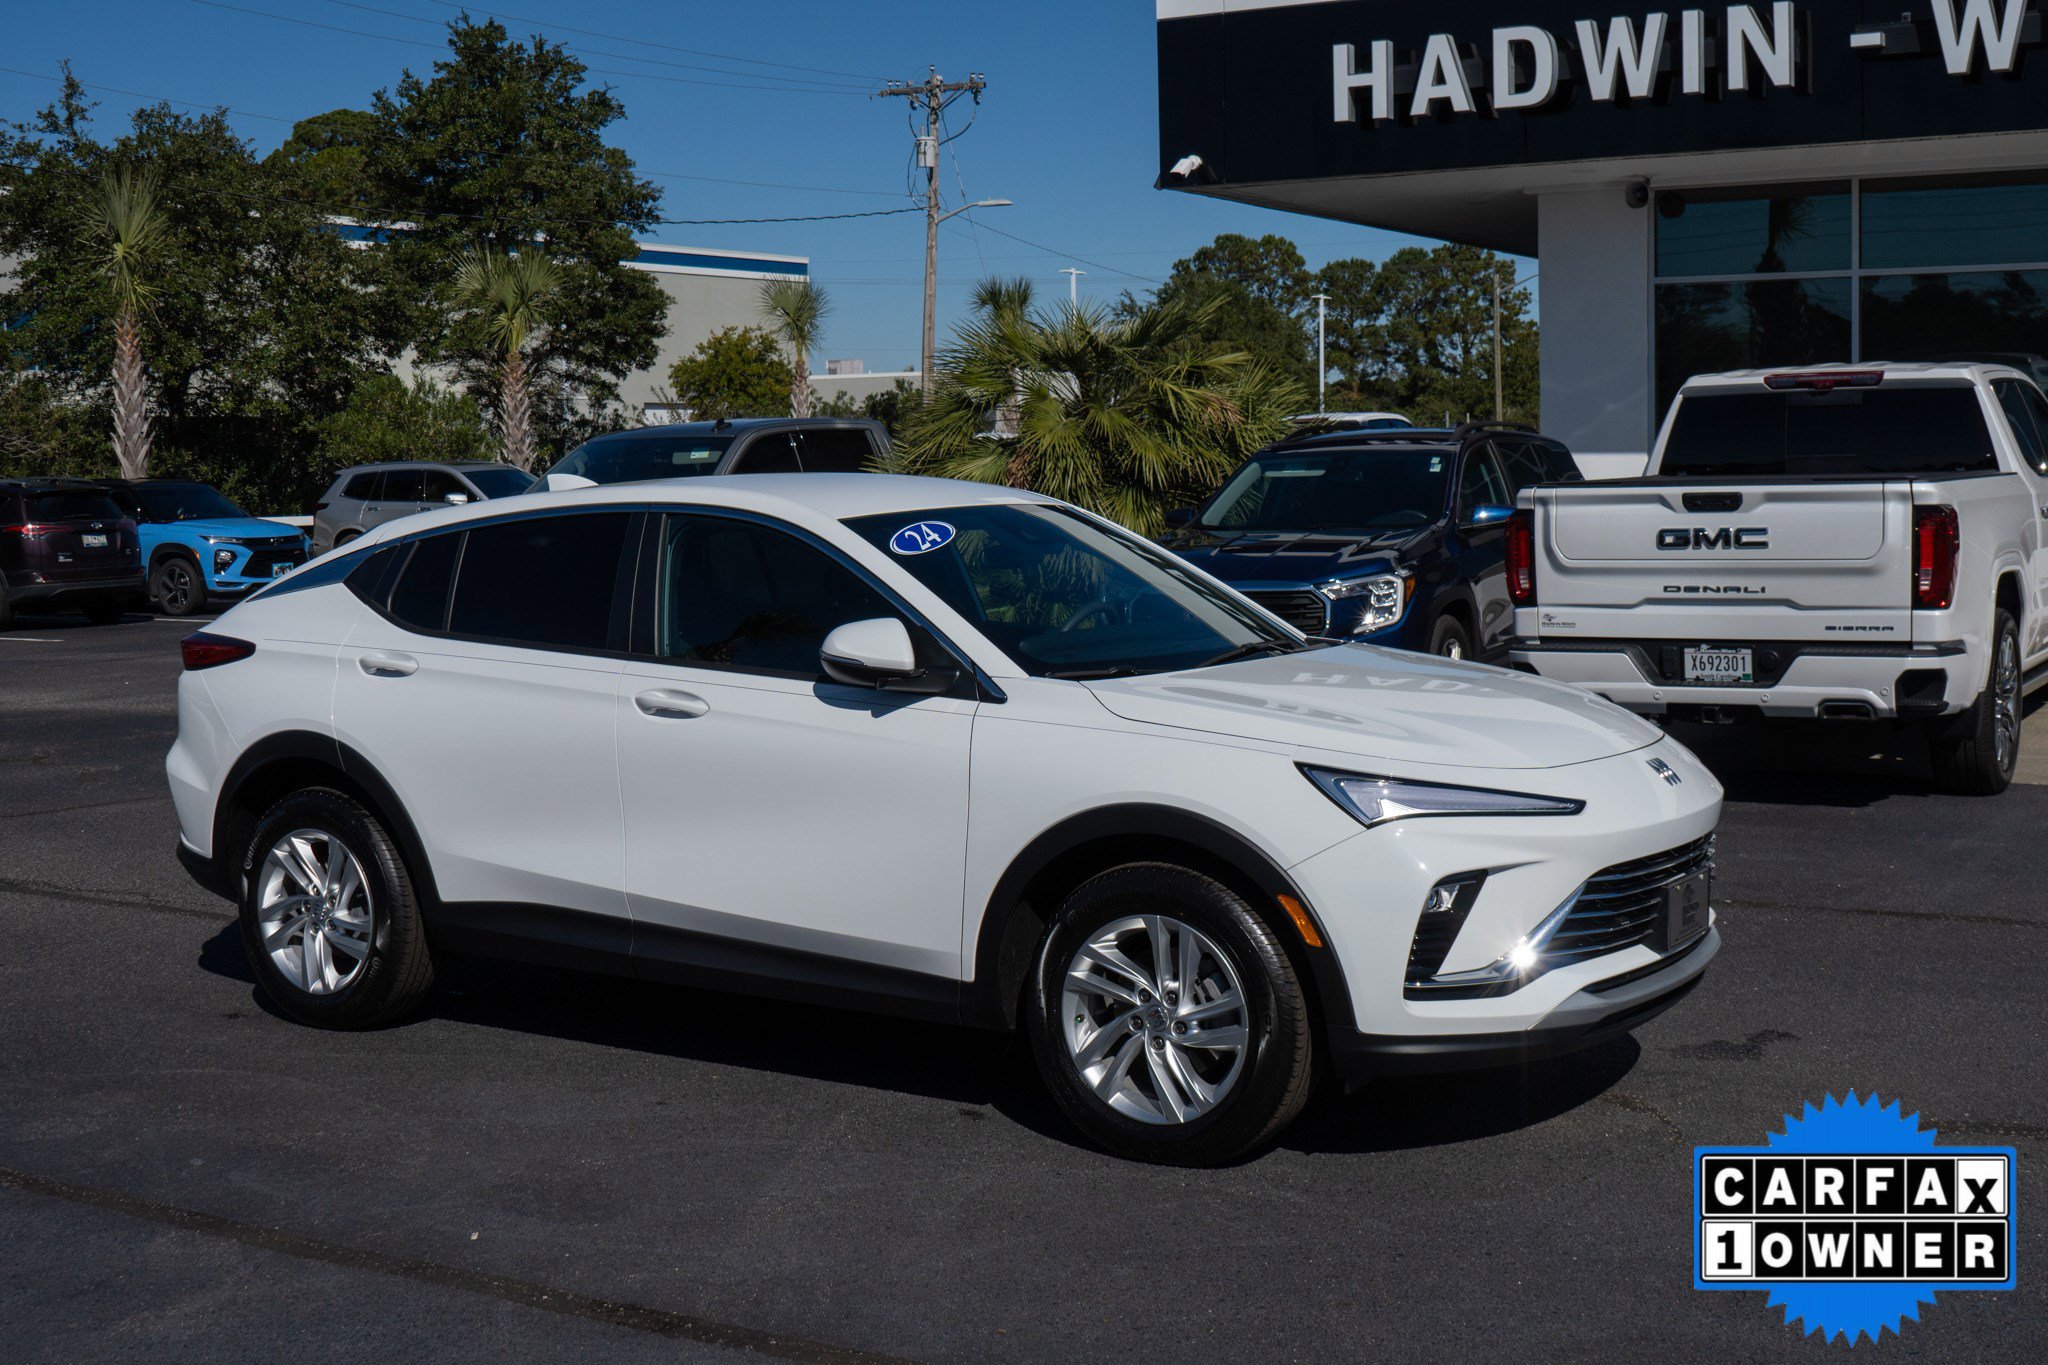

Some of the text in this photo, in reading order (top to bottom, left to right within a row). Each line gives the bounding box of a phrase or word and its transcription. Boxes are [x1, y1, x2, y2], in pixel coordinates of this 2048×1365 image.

[1333, 1, 1796, 122] HADWIN
[904, 523, 942, 550] 24
[1656, 527, 1769, 550] GMC
[1663, 585, 1766, 594] DENALI
[1691, 655, 1746, 671] X692301
